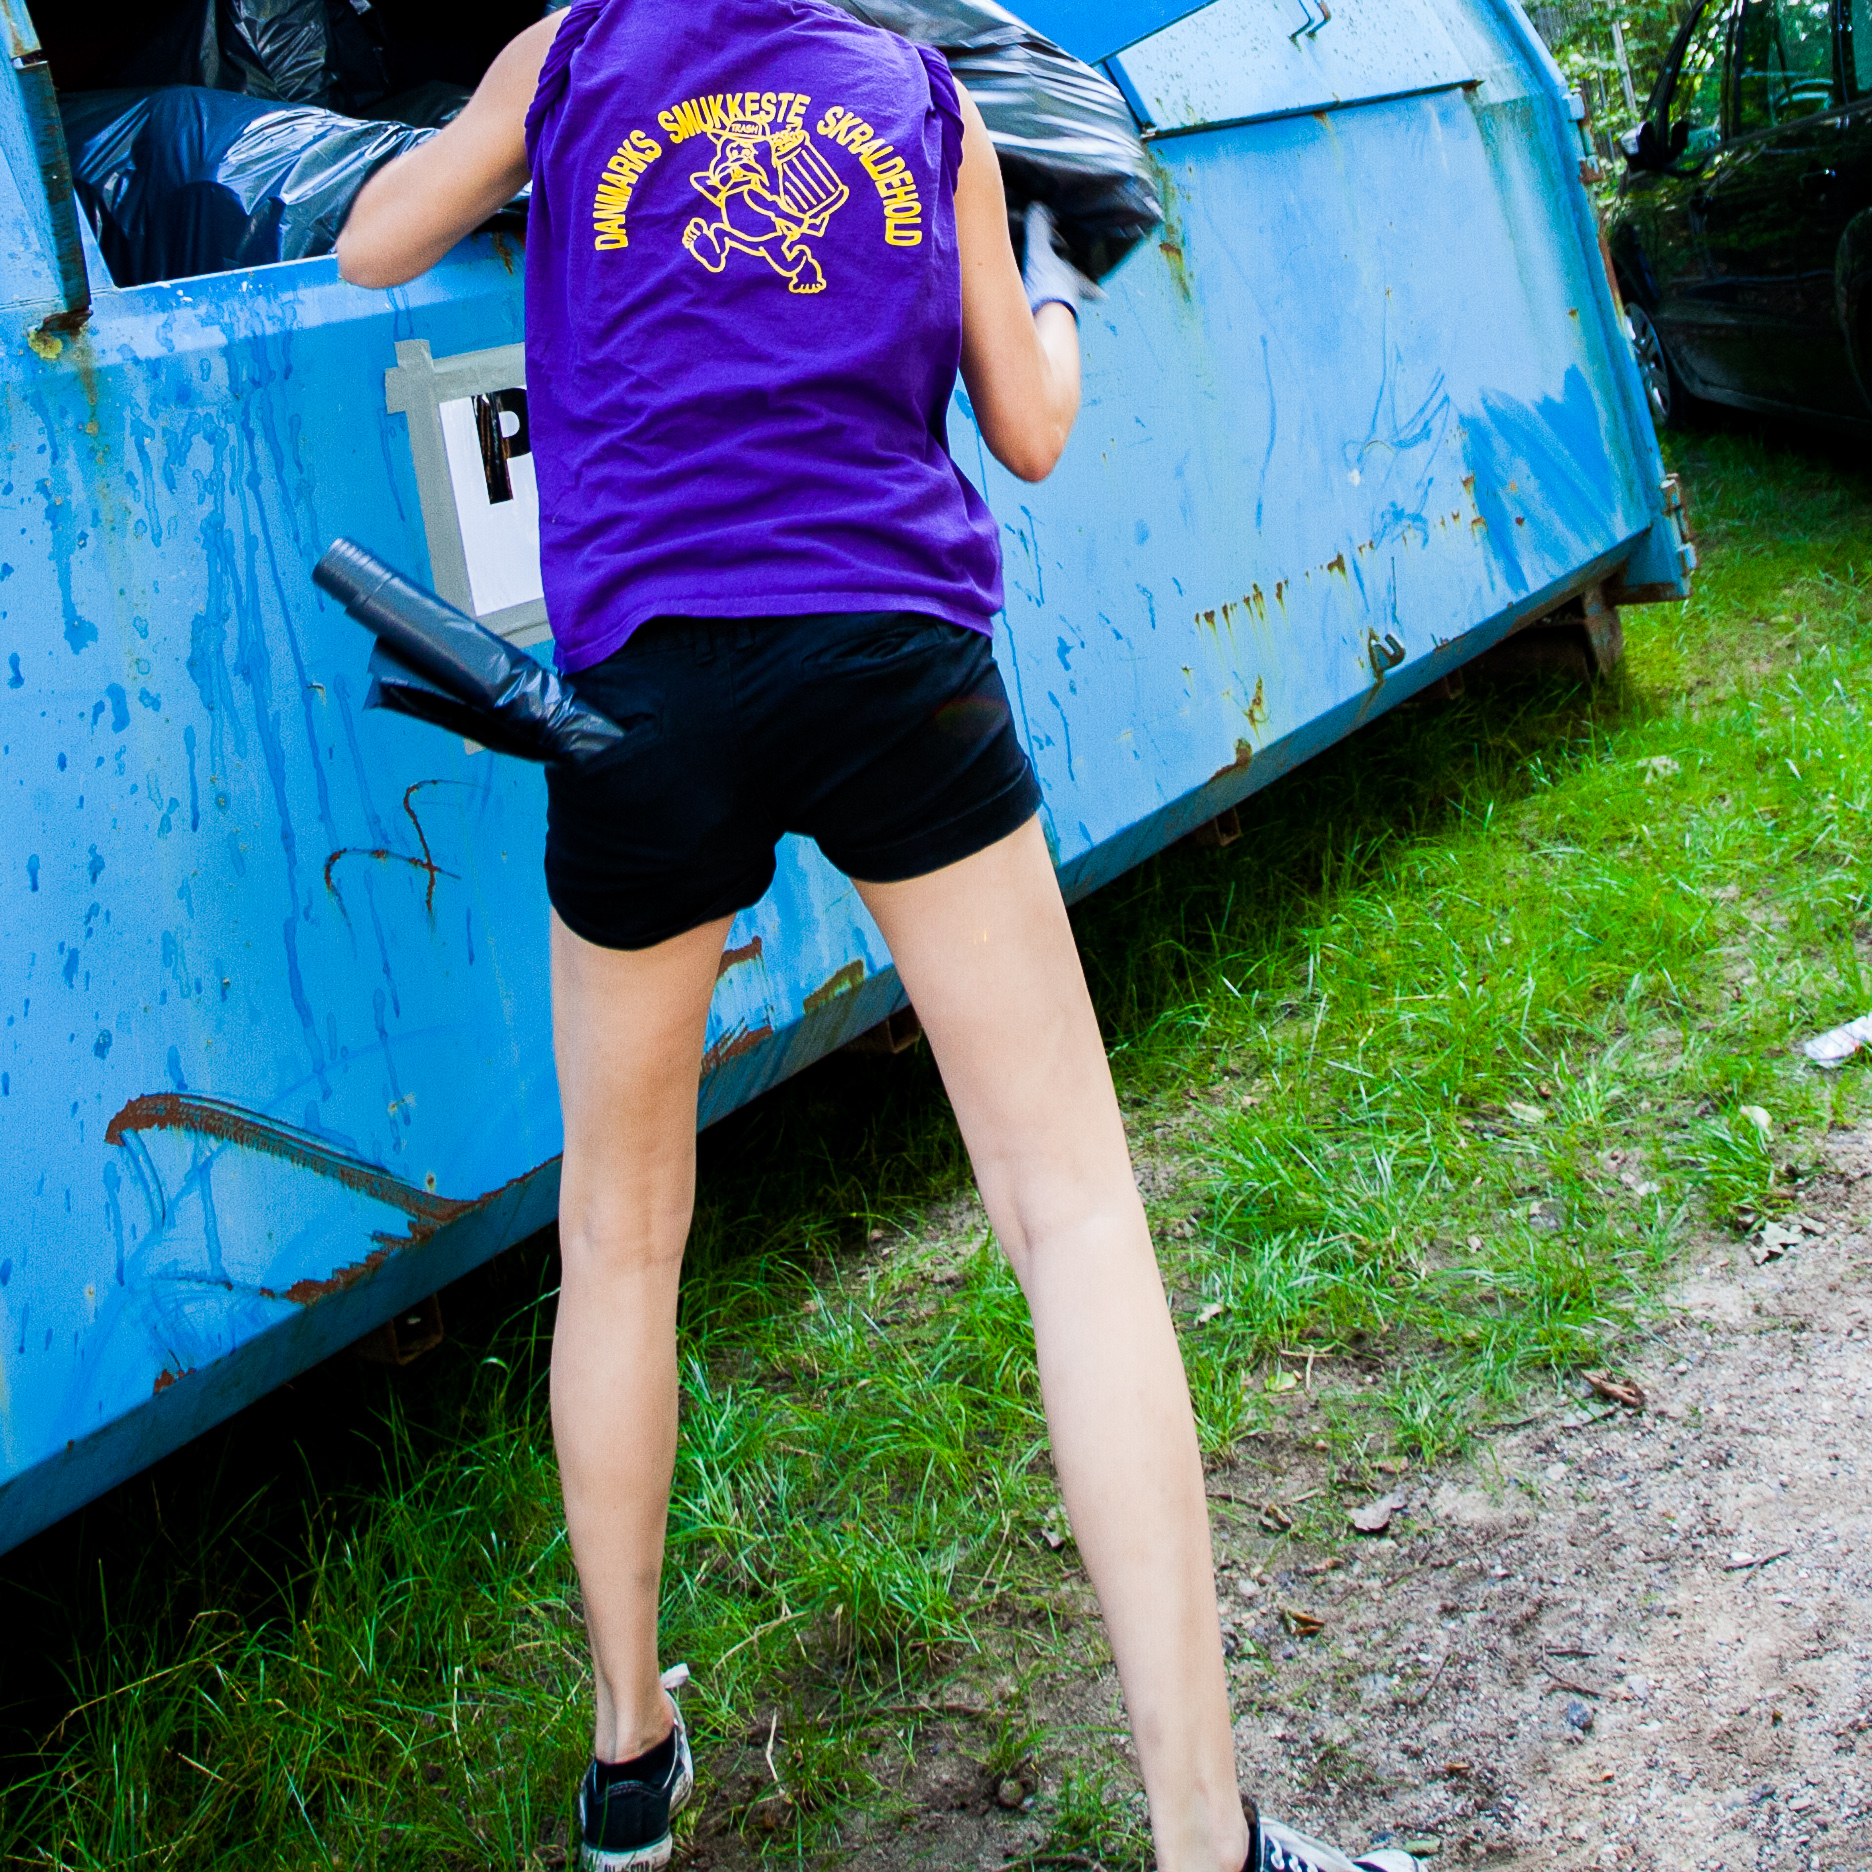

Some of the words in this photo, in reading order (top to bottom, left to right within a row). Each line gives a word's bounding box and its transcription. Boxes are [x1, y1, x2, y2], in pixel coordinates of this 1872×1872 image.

[593, 130, 662, 251] DANMARKS
[658, 92, 811, 143] SMUKKESTE
[817, 105, 922, 247] SKRALDEHOLD
